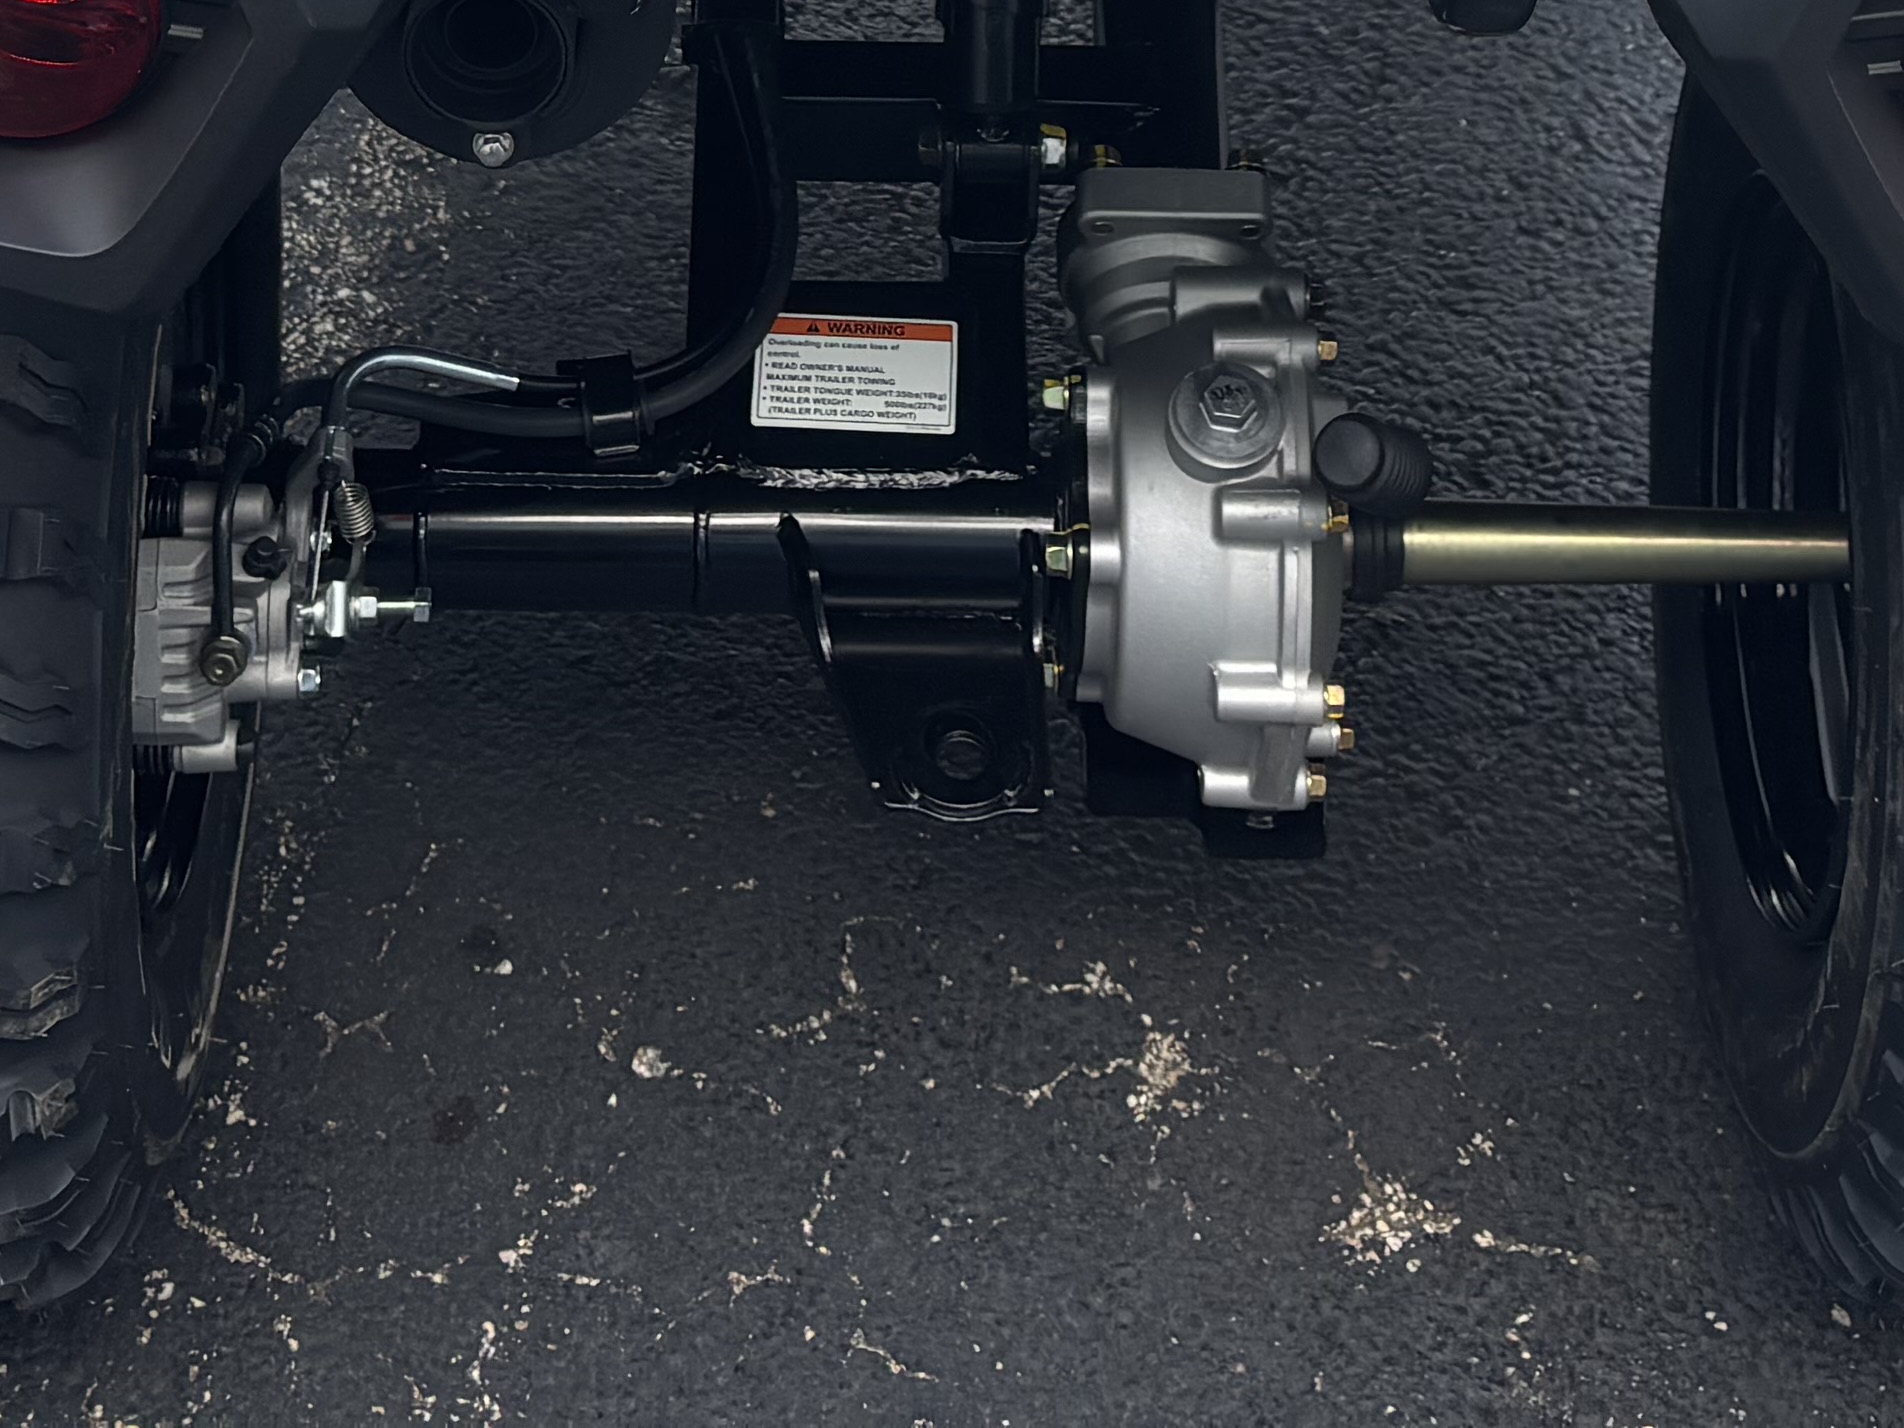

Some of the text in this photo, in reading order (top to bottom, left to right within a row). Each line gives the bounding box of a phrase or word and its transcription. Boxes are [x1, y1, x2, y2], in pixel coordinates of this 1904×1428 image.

[828, 322, 905, 336] WARNING
[768, 338, 821, 349] Overloading
[771, 362, 886, 374] READ OWNER'S MANUAL
[766, 373, 896, 385] MAXIMUM TRAILER TOWING
[770, 384, 811, 393] TRAILER
[813, 386, 854, 396] TONGUE
[770, 395, 811, 404] TRAILER
[768, 406, 917, 421] (TRAILER PLUS CARGO WEIGHT)
